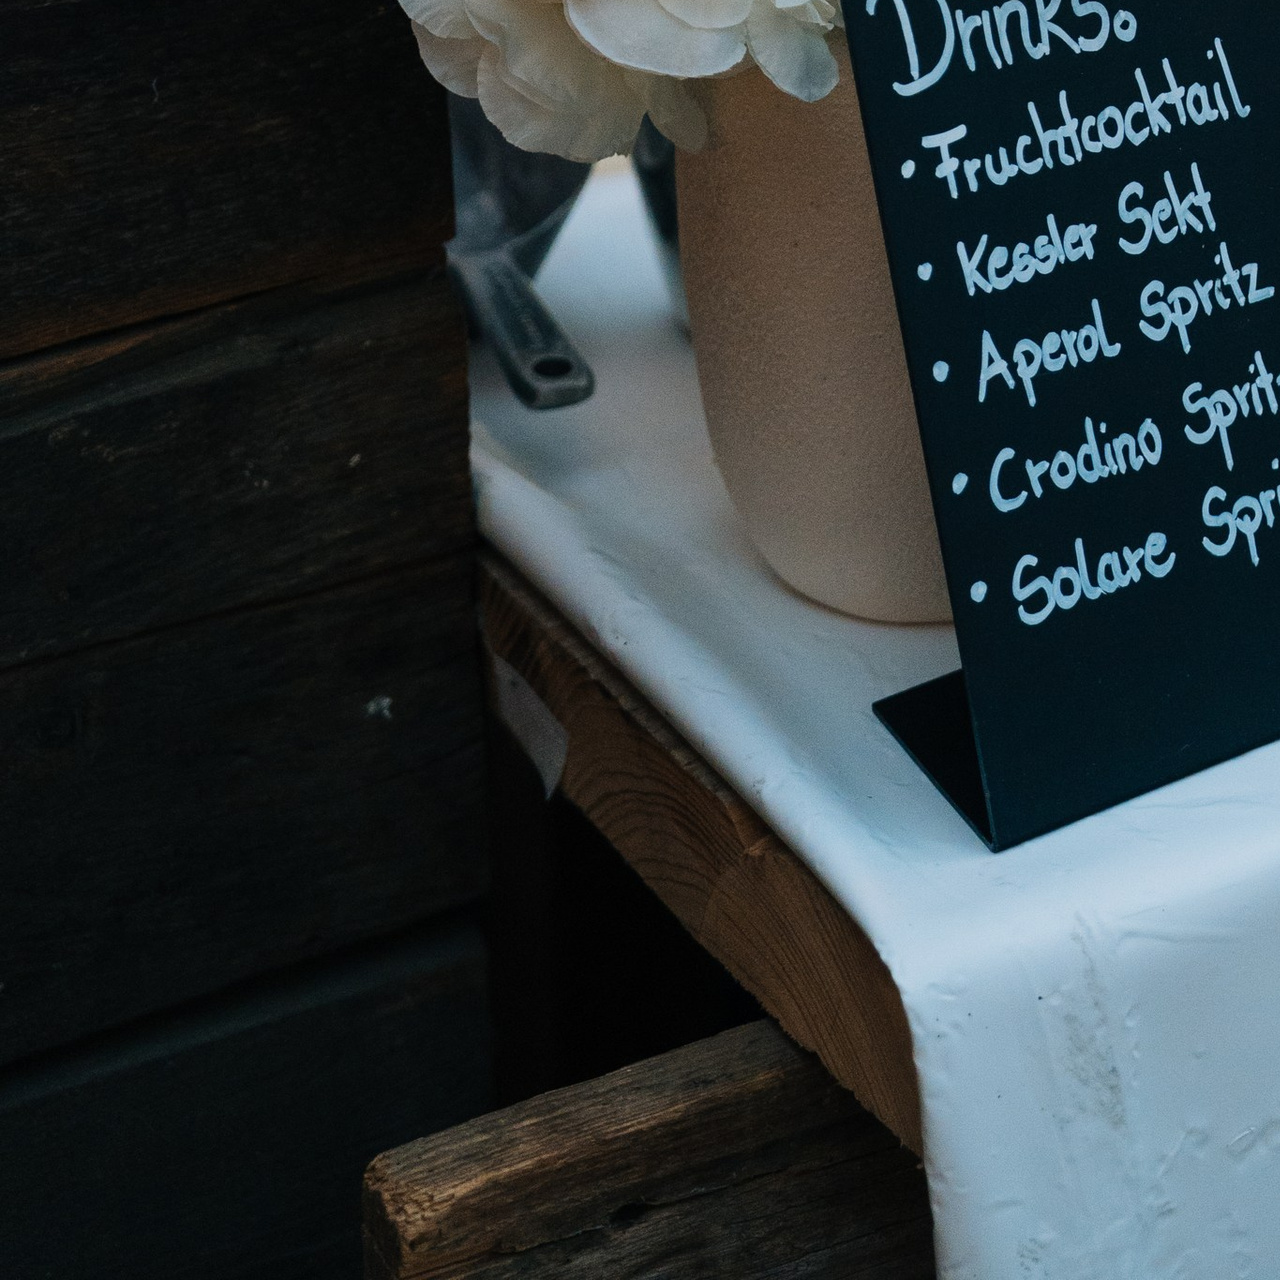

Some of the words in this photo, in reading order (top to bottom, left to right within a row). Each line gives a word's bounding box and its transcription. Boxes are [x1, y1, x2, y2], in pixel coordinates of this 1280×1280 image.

[922, 38, 1251, 199] Fruchtcocktail
[957, 214, 1098, 296] Kessler
[1118, 162, 1217, 255] Sekt
[978, 298, 1122, 407] Aperol
[1139, 242, 1275, 354] Spritz
[989, 416, 1163, 512] Crodino
[1012, 532, 1176, 626] Solare
